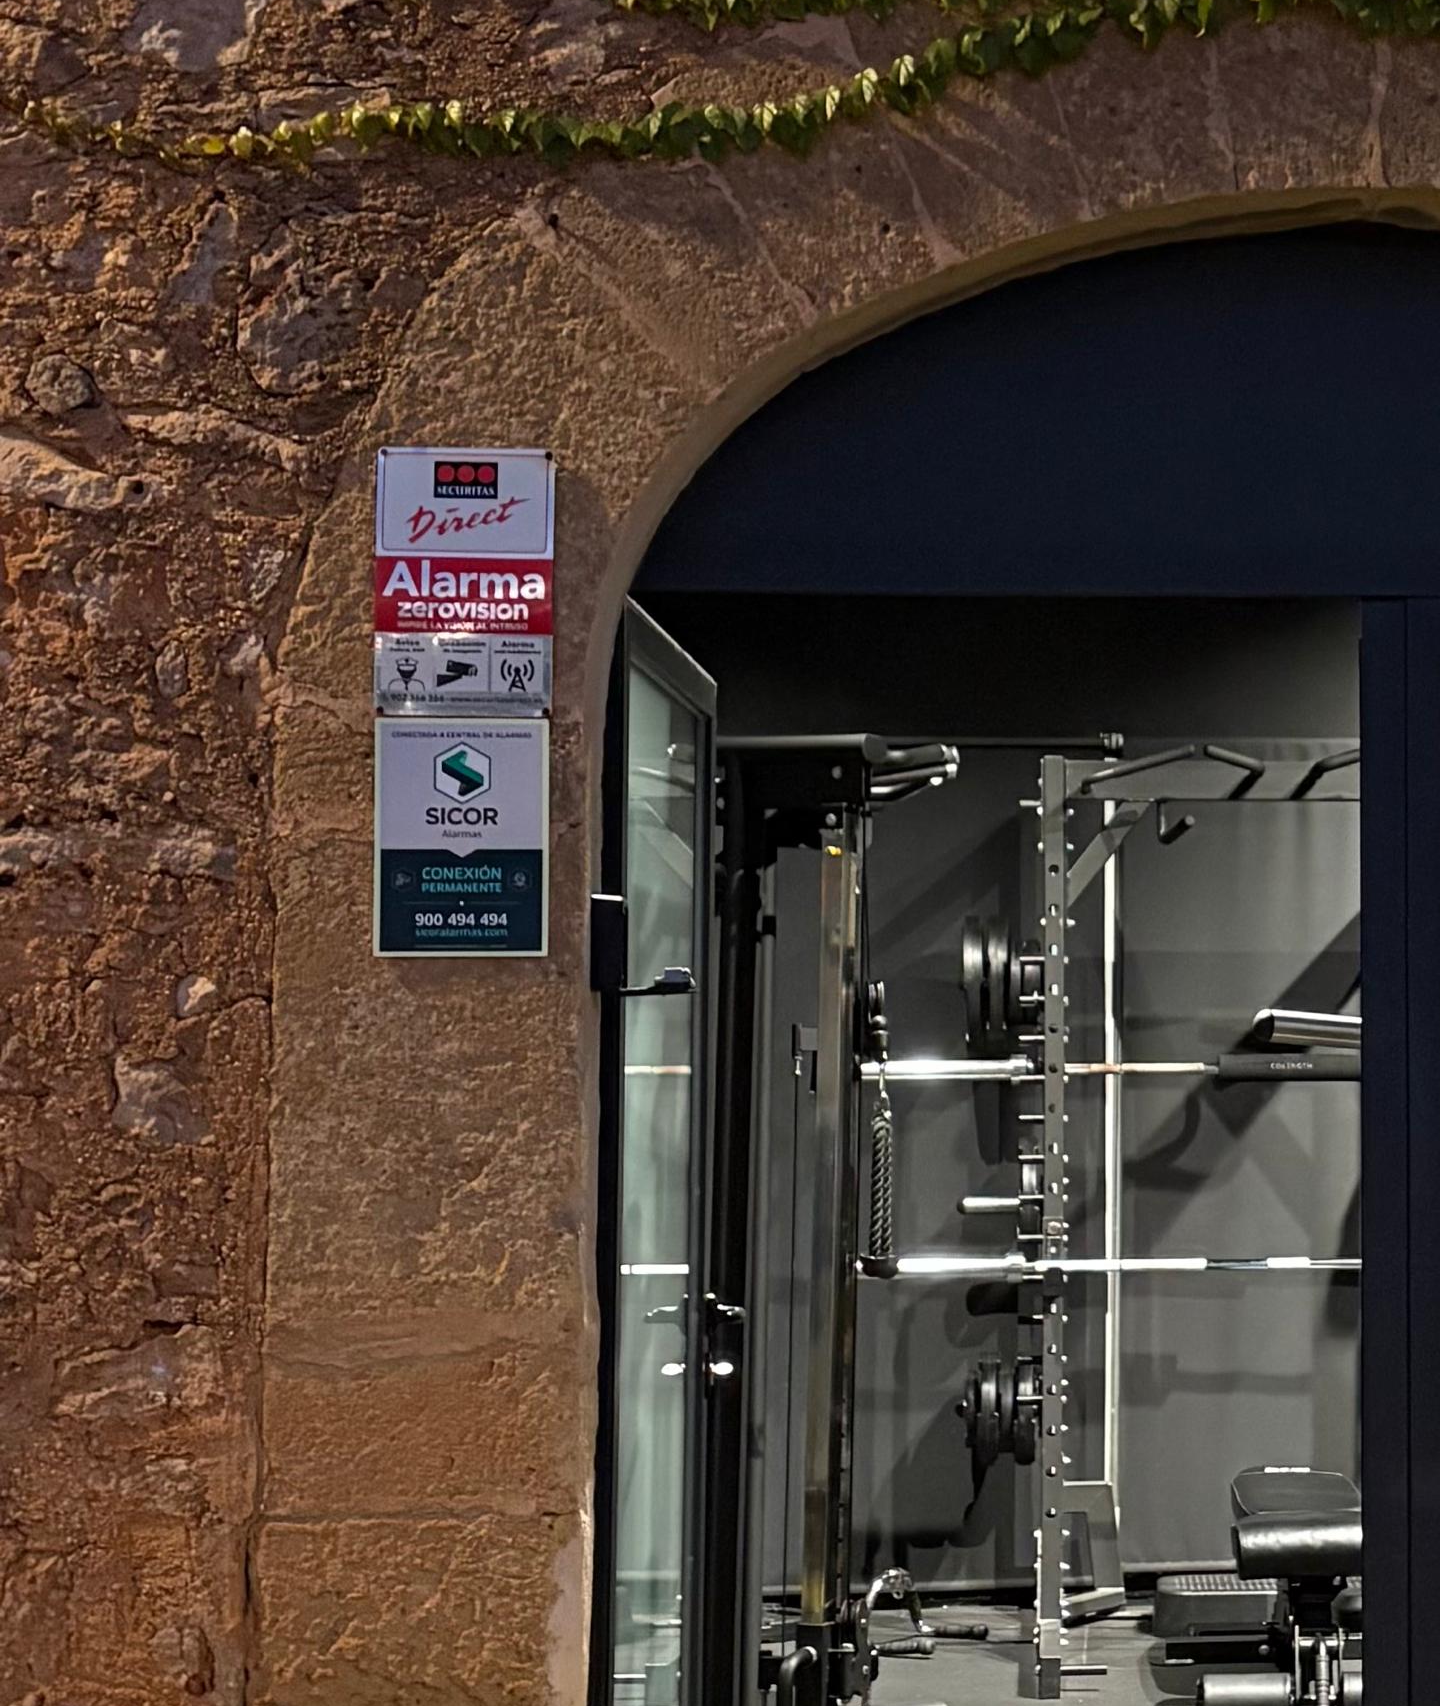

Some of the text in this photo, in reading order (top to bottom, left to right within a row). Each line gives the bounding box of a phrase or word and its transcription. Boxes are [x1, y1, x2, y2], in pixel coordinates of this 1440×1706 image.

[437, 485, 495, 496] SECURITAS
[406, 496, 531, 544] Direct
[382, 560, 546, 600] Alarma
[397, 600, 529, 620] zerovision
[425, 807, 499, 826] SICOR
[441, 829, 482, 839] Alarmas
[421, 865, 502, 880] CONEXIÓN
[421, 882, 502, 893] PERMANENTE
[415, 913, 507, 926] 900 494 494
[415, 928, 508, 938] sicoralarmas.com
